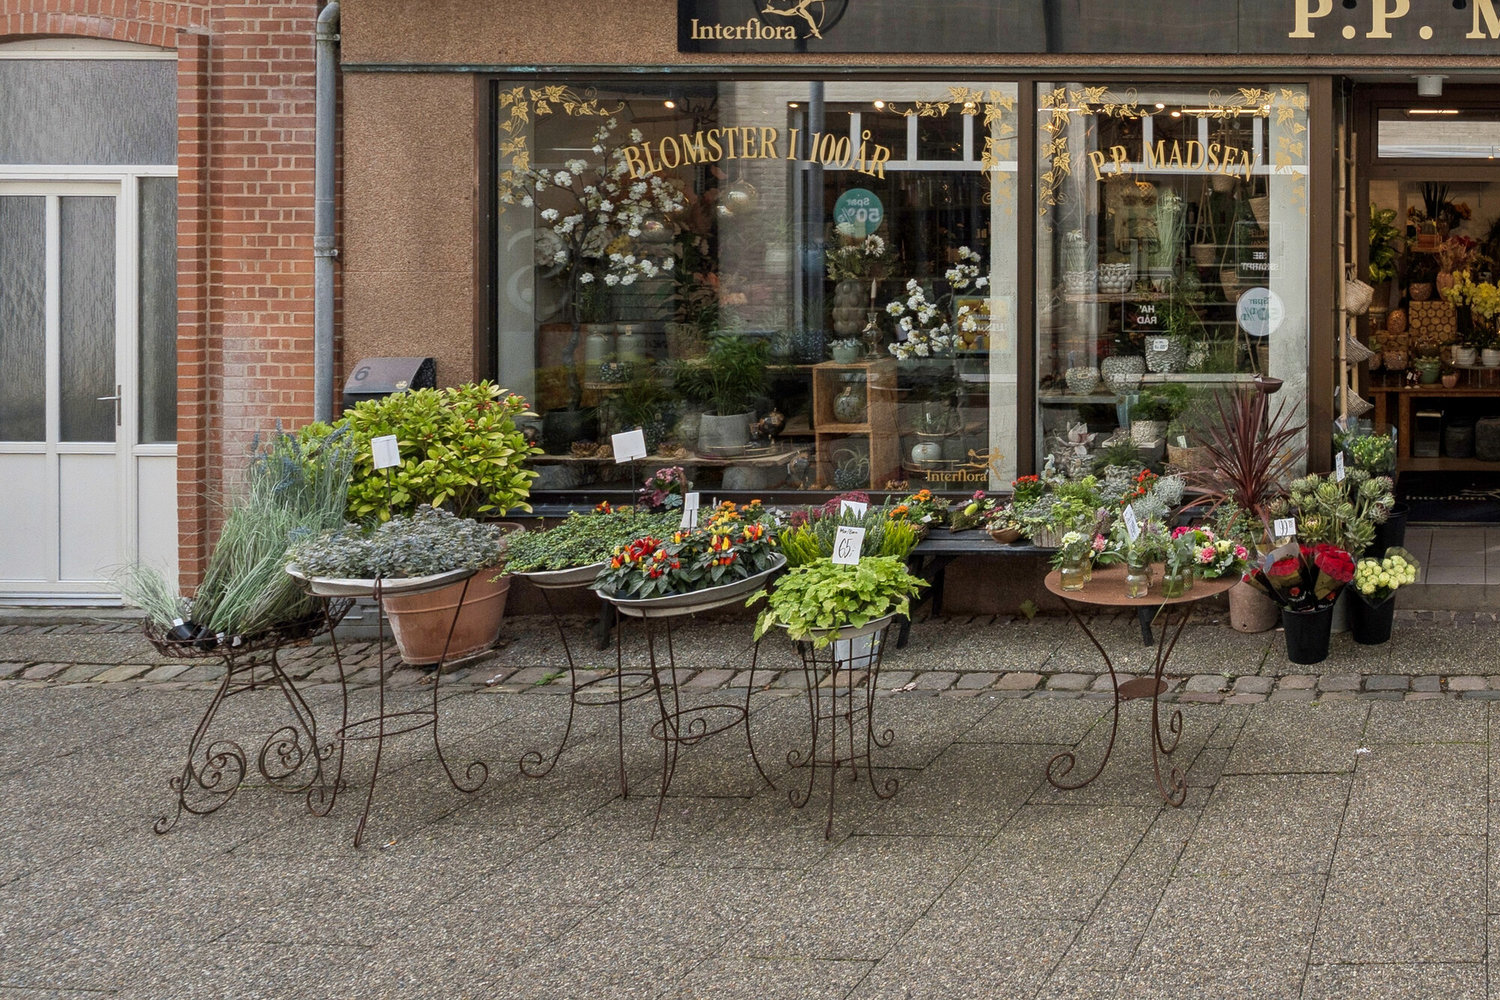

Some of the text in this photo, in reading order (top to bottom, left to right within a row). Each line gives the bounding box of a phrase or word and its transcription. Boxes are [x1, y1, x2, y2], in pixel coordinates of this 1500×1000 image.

[690, 17, 797, 40] Interflora
[622, 126, 778, 180] BLOMSTER
[786, 128, 799, 161] I
[1088, 139, 1259, 182] P.P. MADSEN
[354, 366, 371, 381] 6
[926, 469, 987, 482] Interflora
